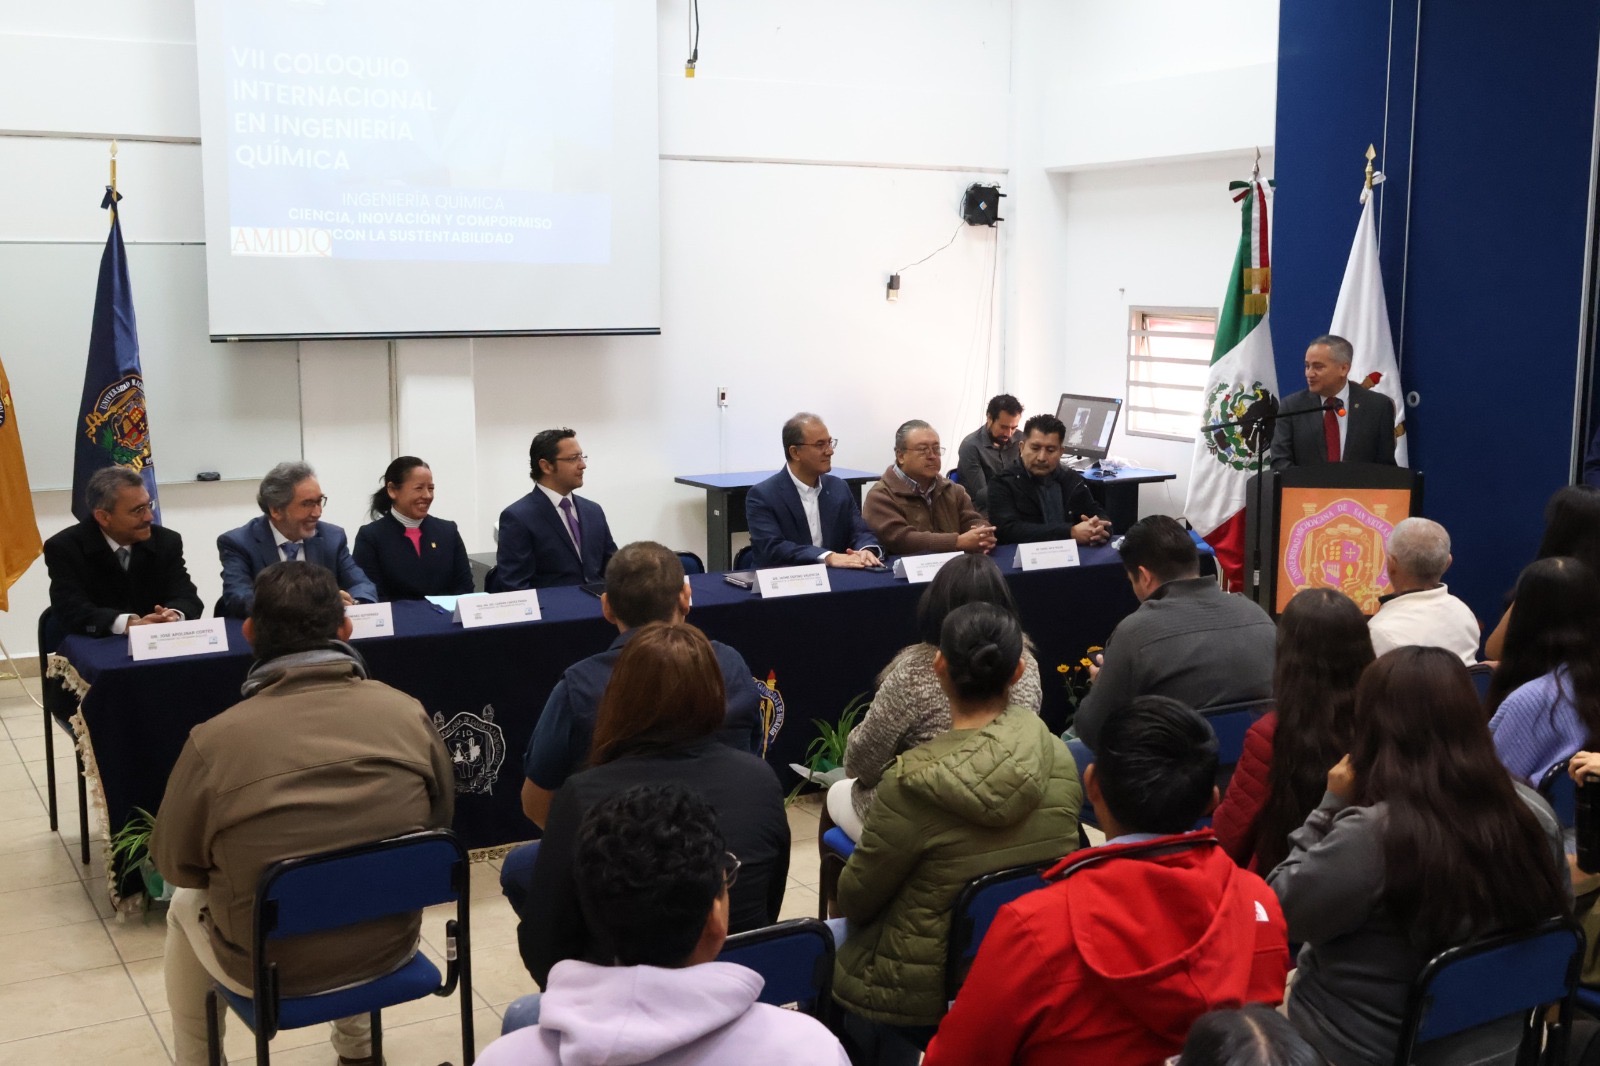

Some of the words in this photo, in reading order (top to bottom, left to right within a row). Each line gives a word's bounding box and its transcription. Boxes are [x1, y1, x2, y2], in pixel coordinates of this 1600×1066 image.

[232, 46, 265, 70] VII
[273, 51, 410, 79] COLOQUIO
[233, 79, 438, 111] INTERNACIONAL
[234, 112, 266, 133] EN
[274, 113, 414, 141] INGENIERÍA
[235, 138, 350, 170] QUÍMICA
[288, 207, 355, 225] CIENCIA,
[358, 209, 441, 225] INOVACIÓN
[444, 214, 454, 225] Y
[456, 214, 553, 230] COMPORMISO
[231, 227, 332, 257] AMIDIQ
[333, 228, 366, 241] CON
[369, 230, 386, 241] LA
[389, 229, 515, 244] SUSTENTABILIDAD
[1337, 504, 1348, 512] DE
